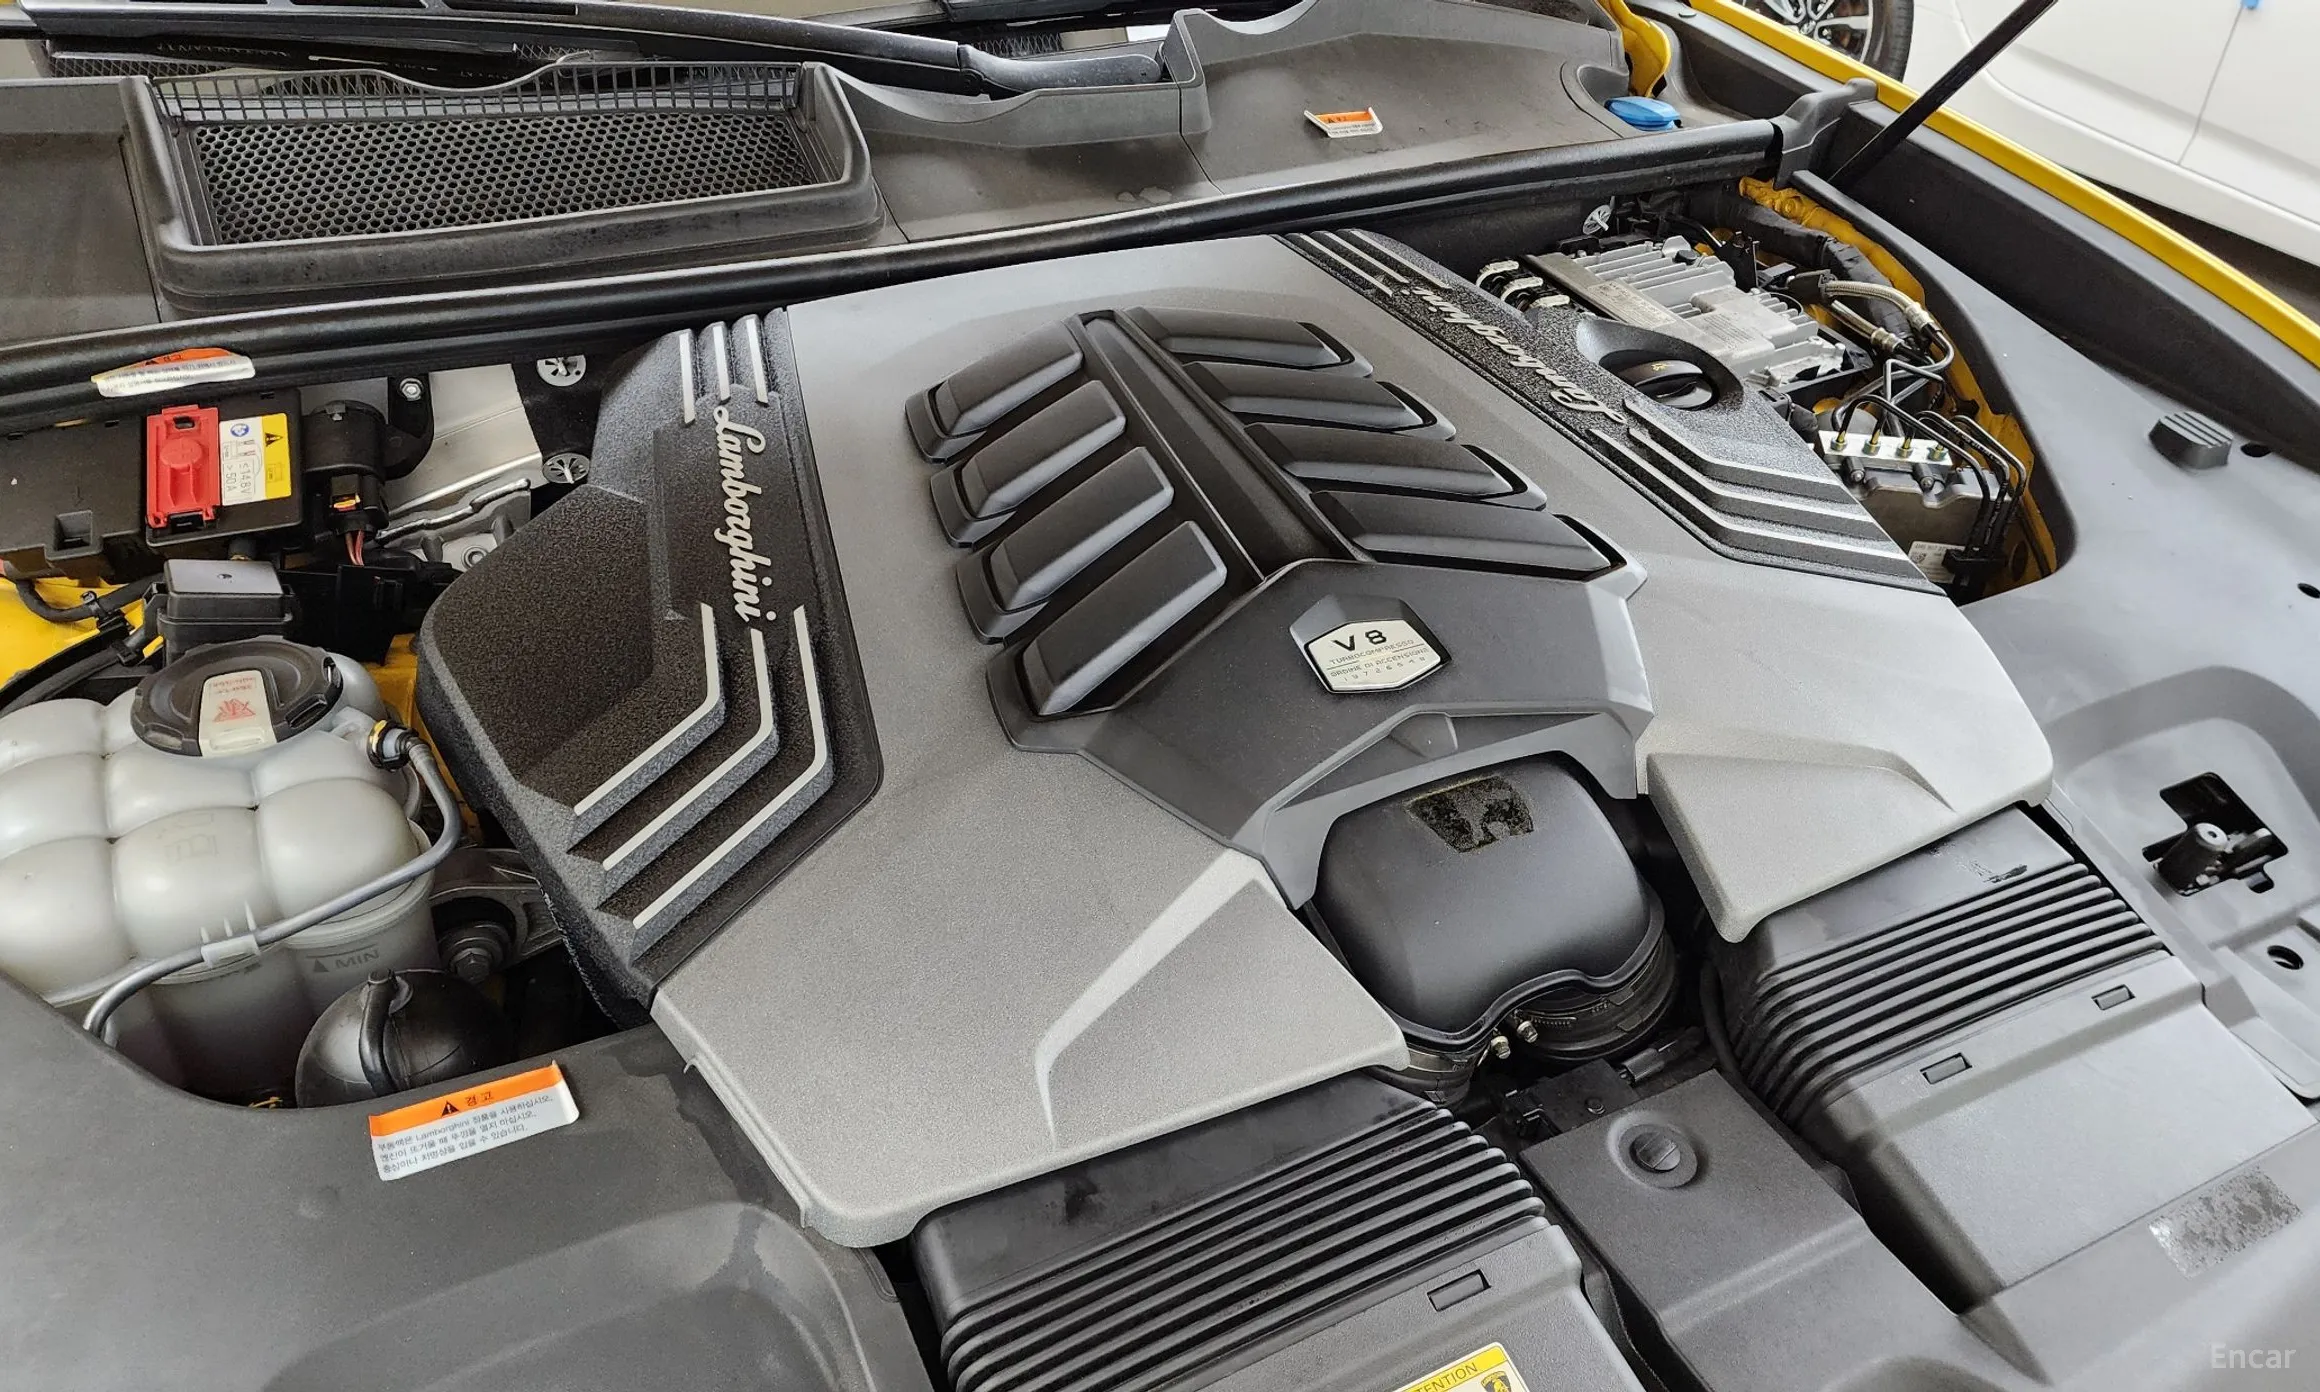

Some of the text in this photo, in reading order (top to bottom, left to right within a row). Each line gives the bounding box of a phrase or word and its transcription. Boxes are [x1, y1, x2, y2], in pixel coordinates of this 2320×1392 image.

[1401, 286, 1628, 425] Lamborghini
[713, 405, 777, 622] Lamborghini
[335, 949, 380, 969] MIN
[415, 1119, 470, 1141] Lamborghini
